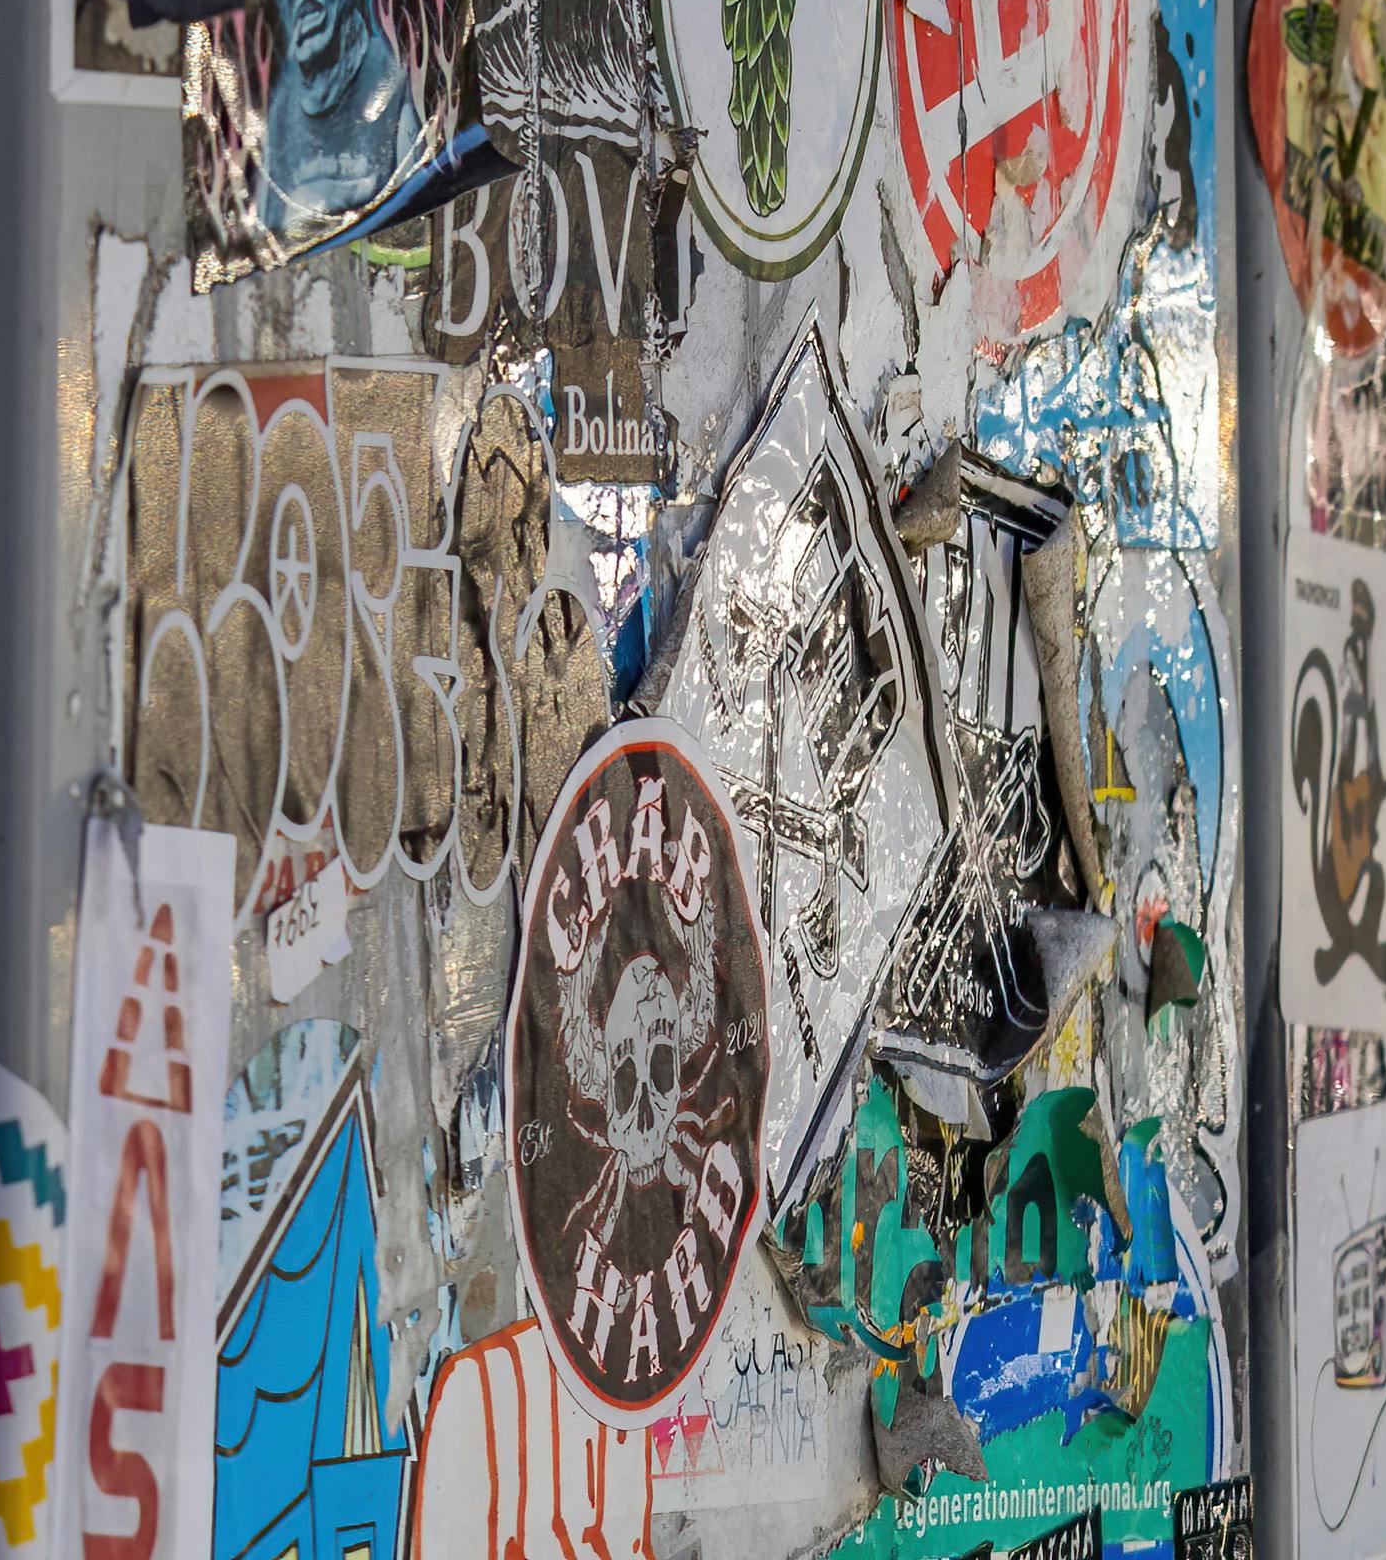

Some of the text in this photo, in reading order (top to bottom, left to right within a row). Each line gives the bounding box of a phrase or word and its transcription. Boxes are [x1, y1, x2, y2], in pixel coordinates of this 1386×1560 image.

[563, 370, 673, 460] Bolina
[545, 776, 711, 973] CRAB
[567, 1141, 741, 1385] HARD
